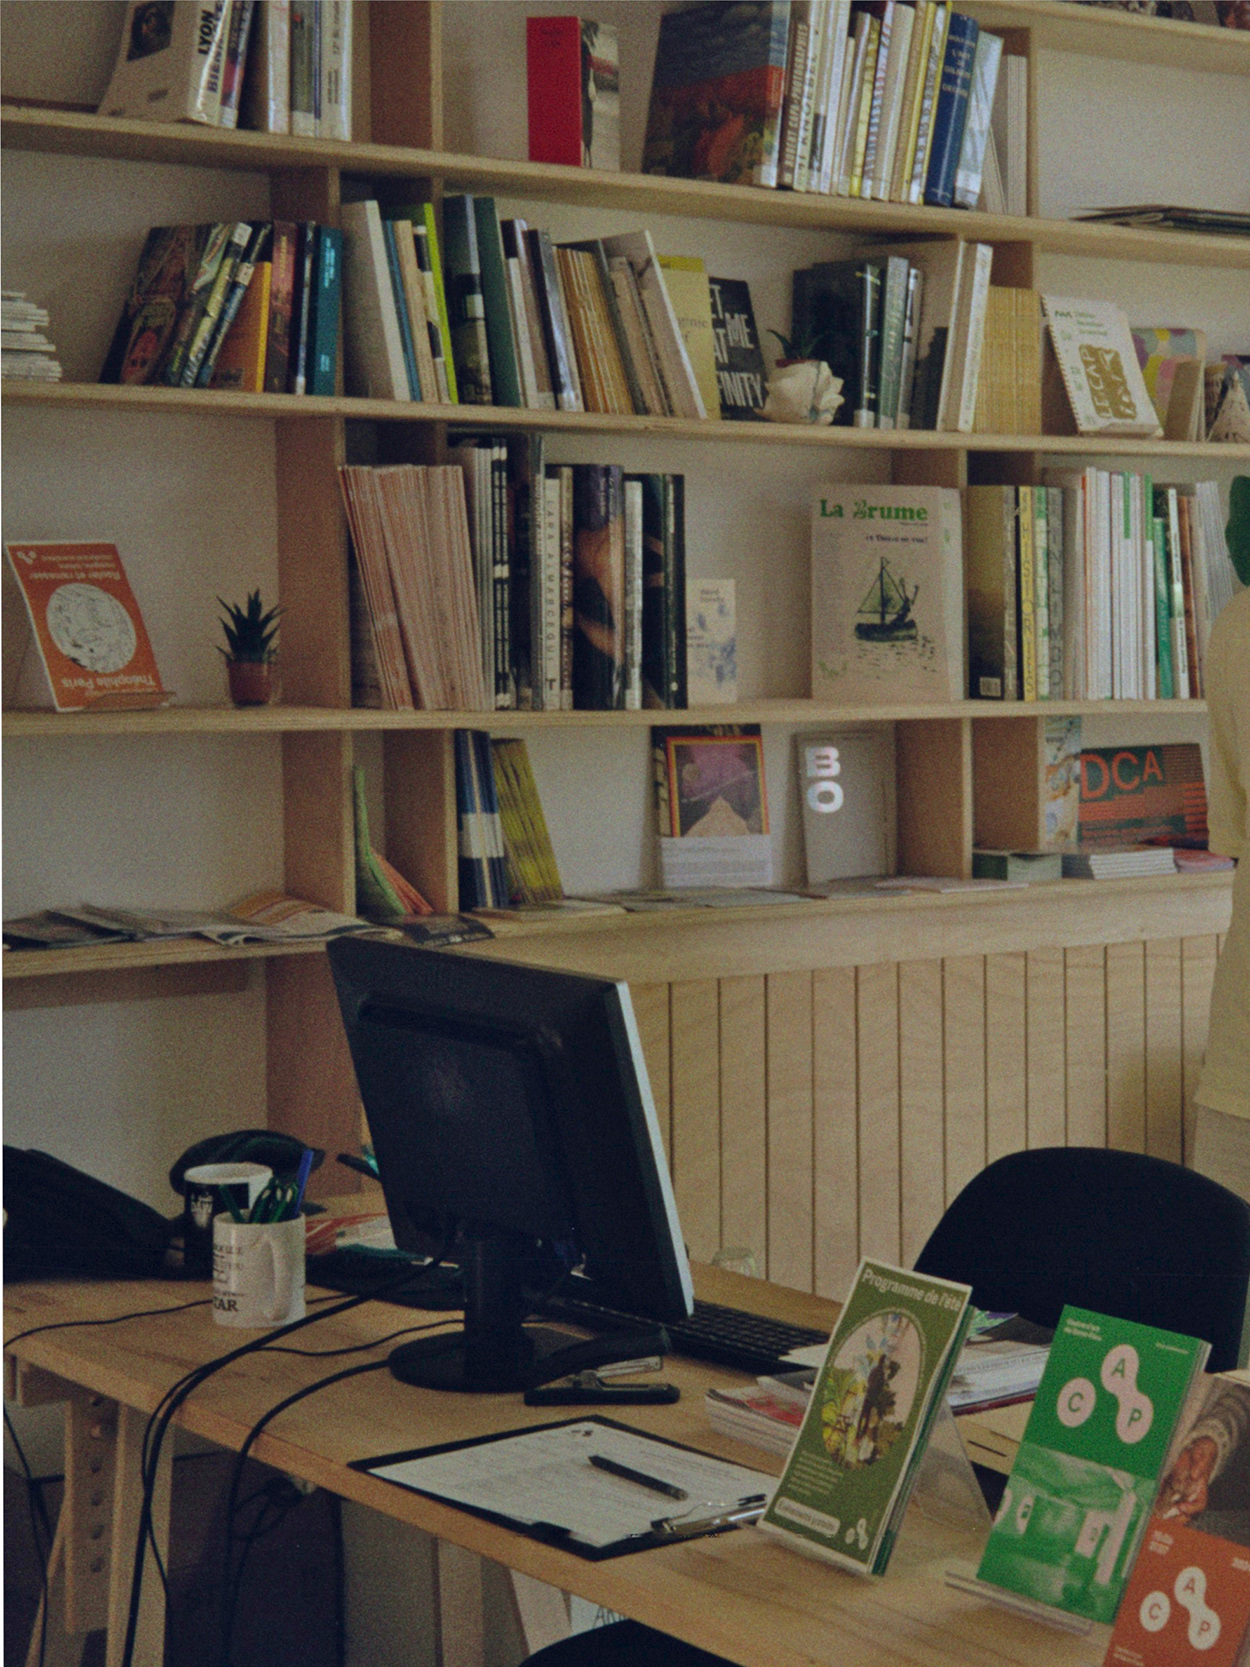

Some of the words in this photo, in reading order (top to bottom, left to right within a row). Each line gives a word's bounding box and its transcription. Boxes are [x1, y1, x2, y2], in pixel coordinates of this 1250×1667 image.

[724, 311, 755, 348] ME
[819, 498, 844, 518] La
[853, 500, 929, 521] Brume
[1080, 751, 1163, 799] DCA
[861, 1268, 925, 1302] Programme
[924, 1288, 941, 1306] de
